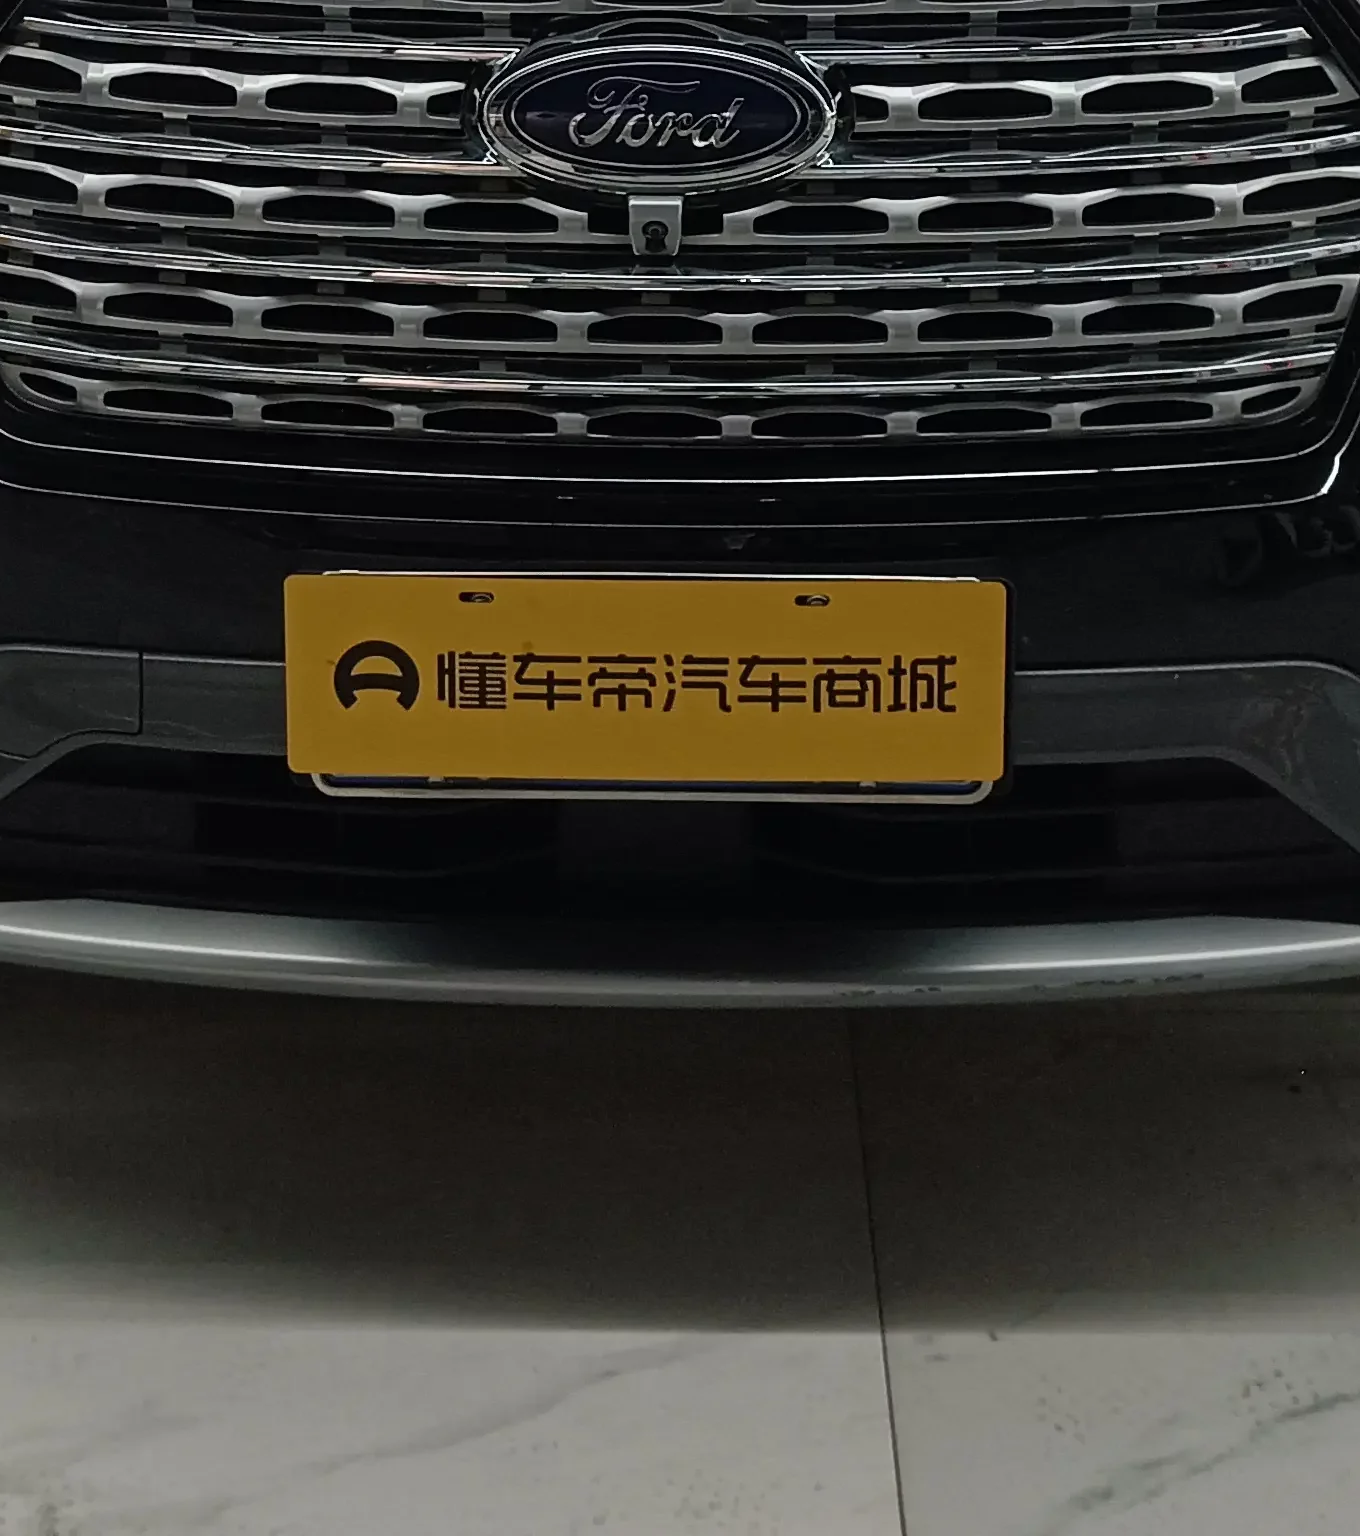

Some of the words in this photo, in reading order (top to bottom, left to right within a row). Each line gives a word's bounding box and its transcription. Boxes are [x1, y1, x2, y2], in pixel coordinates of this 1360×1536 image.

[568, 75, 745, 148] Ford
[436, 651, 958, 714] 懂车帝汽车商城
